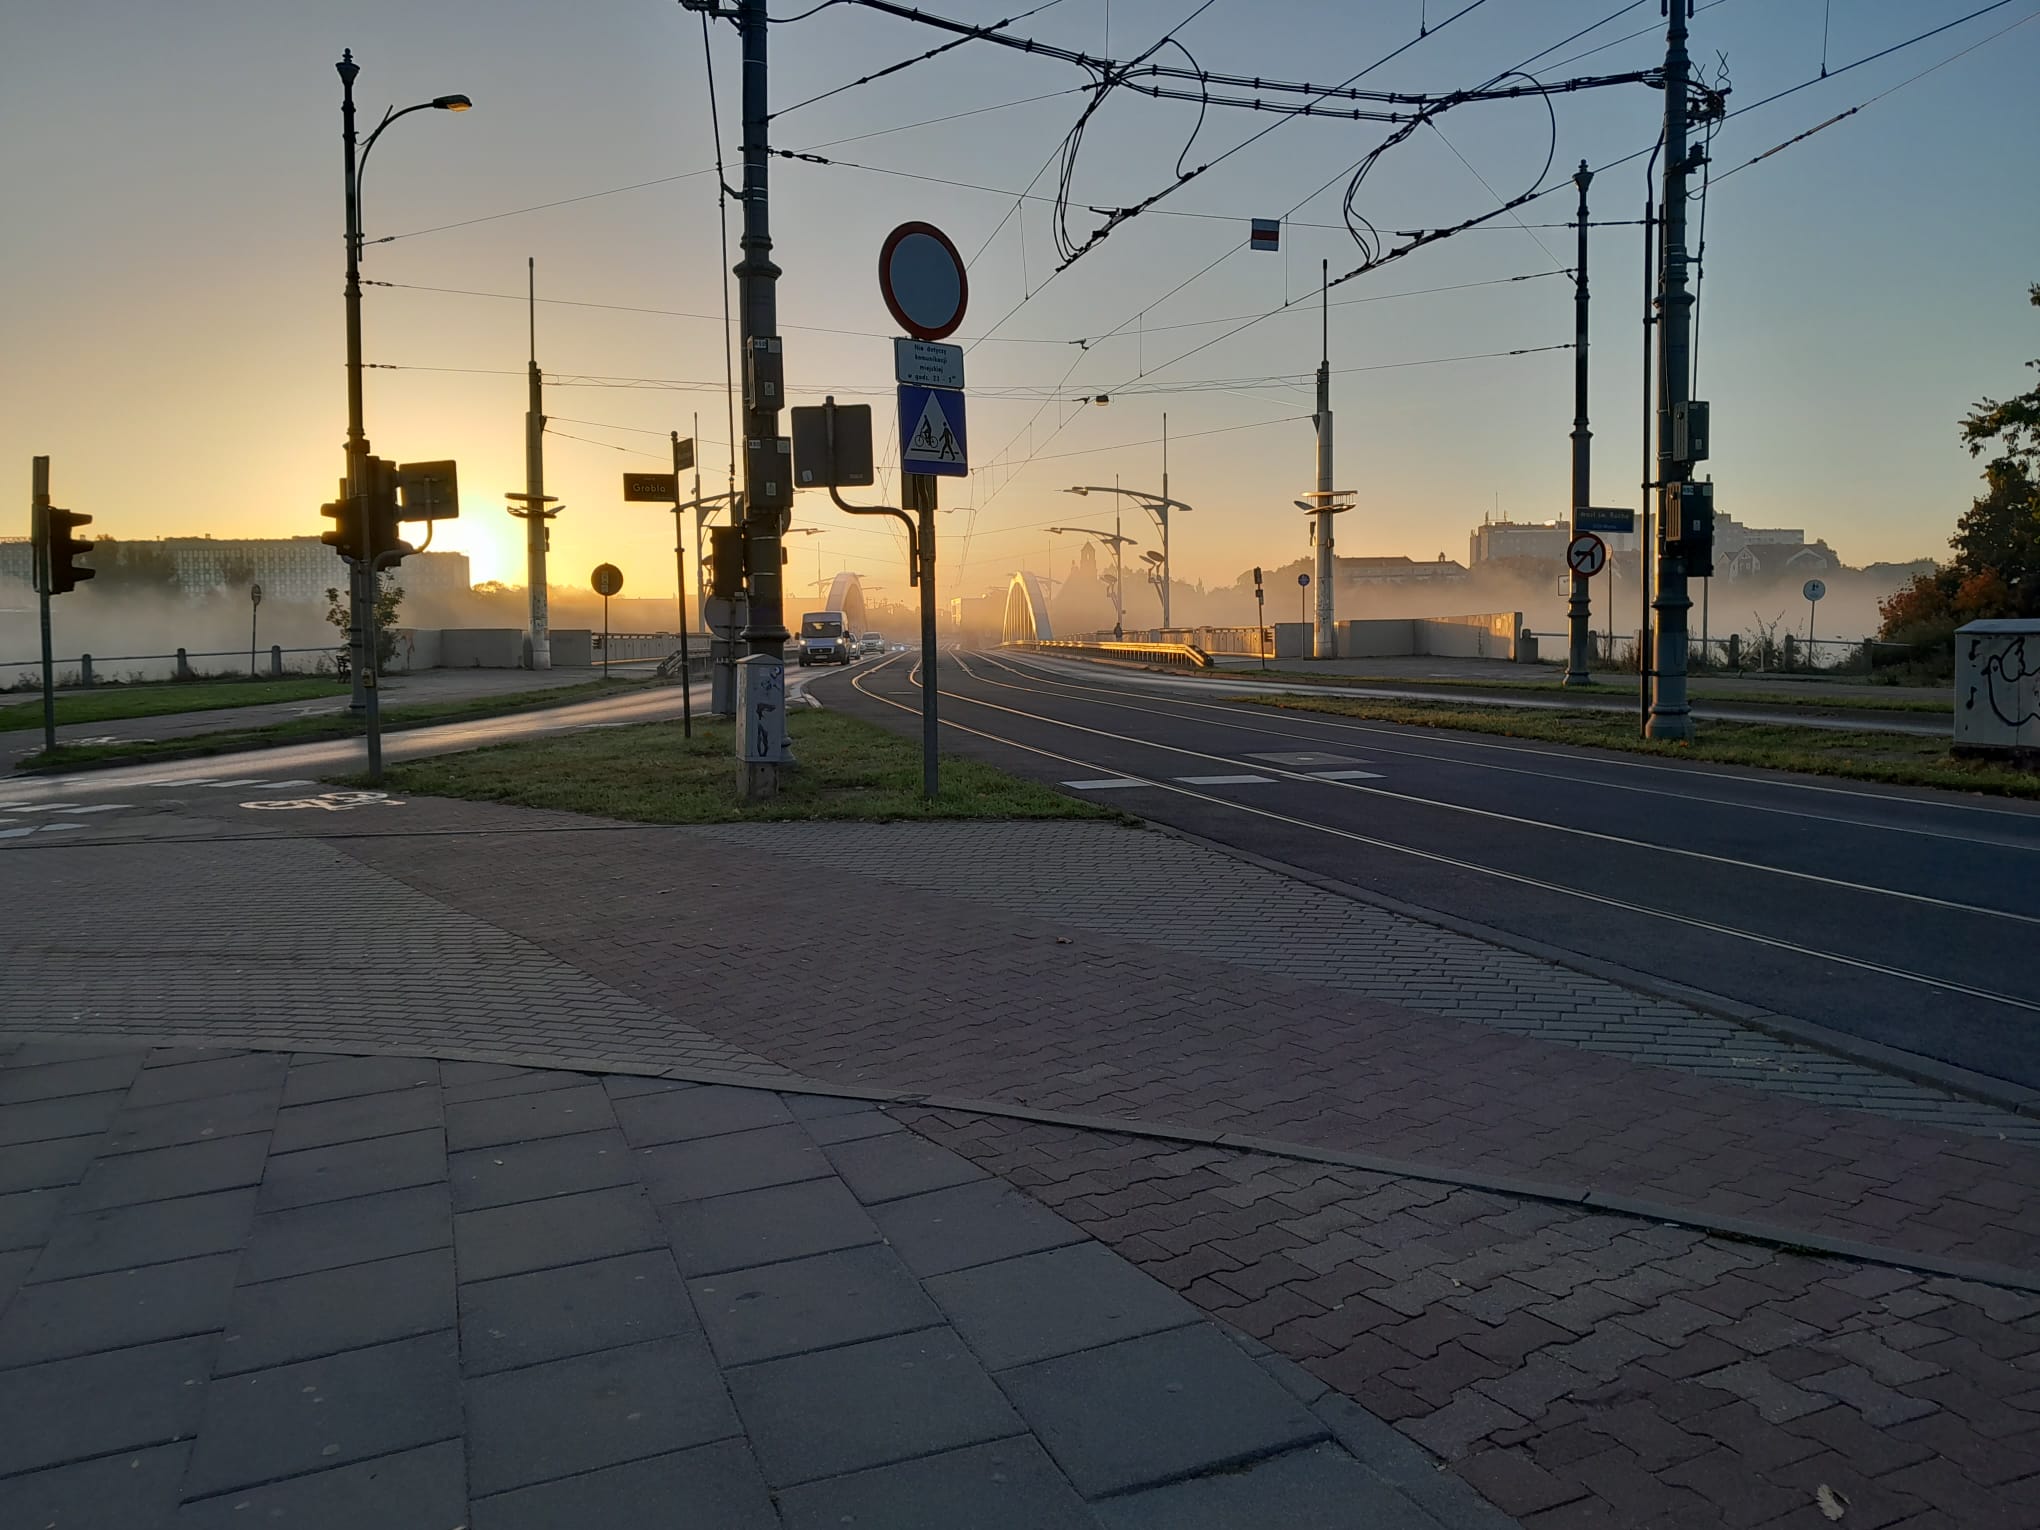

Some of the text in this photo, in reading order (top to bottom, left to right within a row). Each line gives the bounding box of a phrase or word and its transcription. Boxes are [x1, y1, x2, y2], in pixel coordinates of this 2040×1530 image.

[914, 344, 947, 355] Nie dotyczy
[914, 354, 947, 364] komunikacji
[919, 365, 944, 374] miejskiej
[633, 483, 665, 493] Grobla
